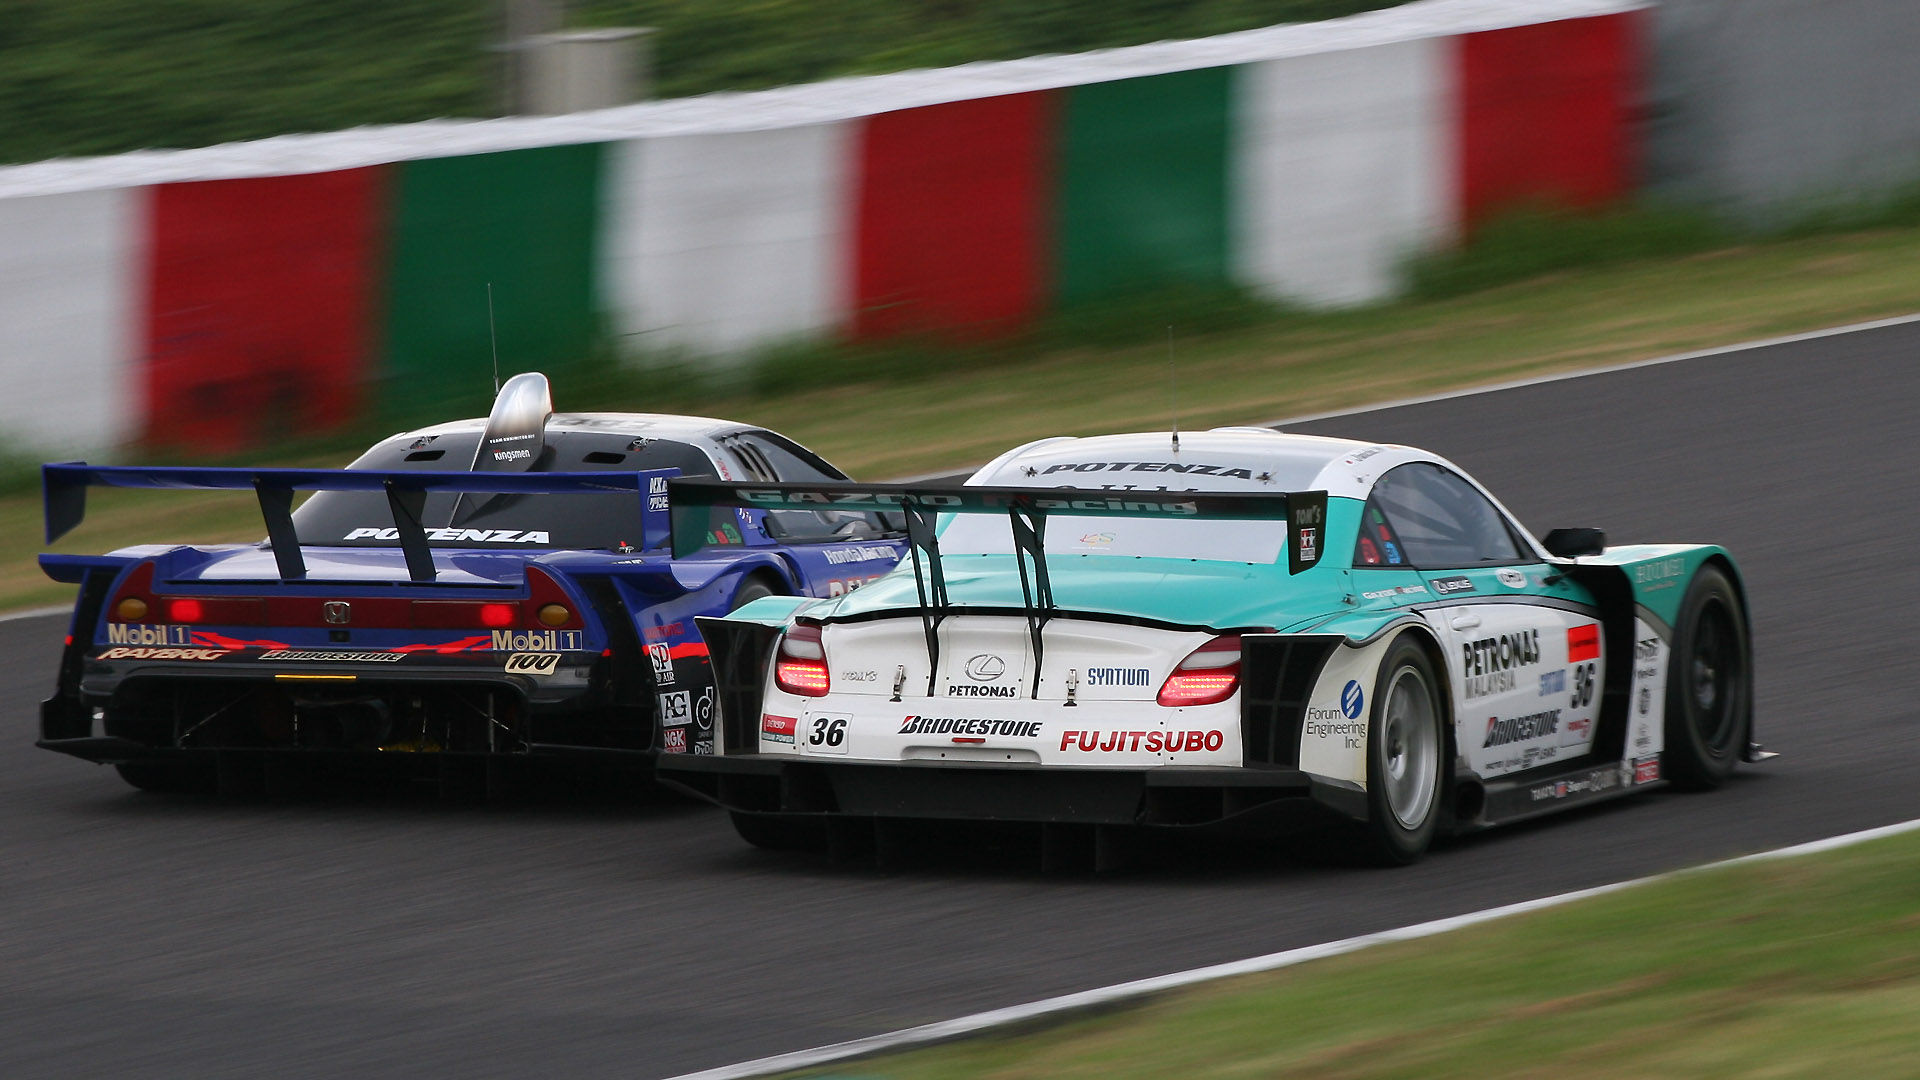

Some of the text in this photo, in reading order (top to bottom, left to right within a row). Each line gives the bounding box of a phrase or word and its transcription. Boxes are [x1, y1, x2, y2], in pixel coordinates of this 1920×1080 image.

[494, 449, 530, 461] Kingsmen
[1041, 462, 1252, 480] POTENZA
[823, 545, 899, 565] Honda Racing
[108, 623, 168, 645] Mobil
[492, 630, 556, 651] Mobil
[258, 649, 408, 662] BRIDGESTONE
[1463, 628, 1540, 678] PETRONAS
[508, 654, 557, 671] 100
[842, 670, 878, 681] TOM'S
[1087, 668, 1149, 686] SYNTIUM
[949, 685, 1016, 698] PETRONAS
[1570, 662, 1597, 709] 36
[664, 693, 687, 719] AG
[1308, 707, 1341, 721] Forum
[809, 717, 847, 747] 36
[898, 715, 1043, 738] BRIDGESTONE
[1306, 721, 1366, 736] Engineering
[1483, 709, 1562, 749] BRIDGESTONE
[664, 730, 685, 748] NGK
[1060, 730, 1224, 753] FUJITSUBO
[1345, 735, 1362, 748] Inc.
